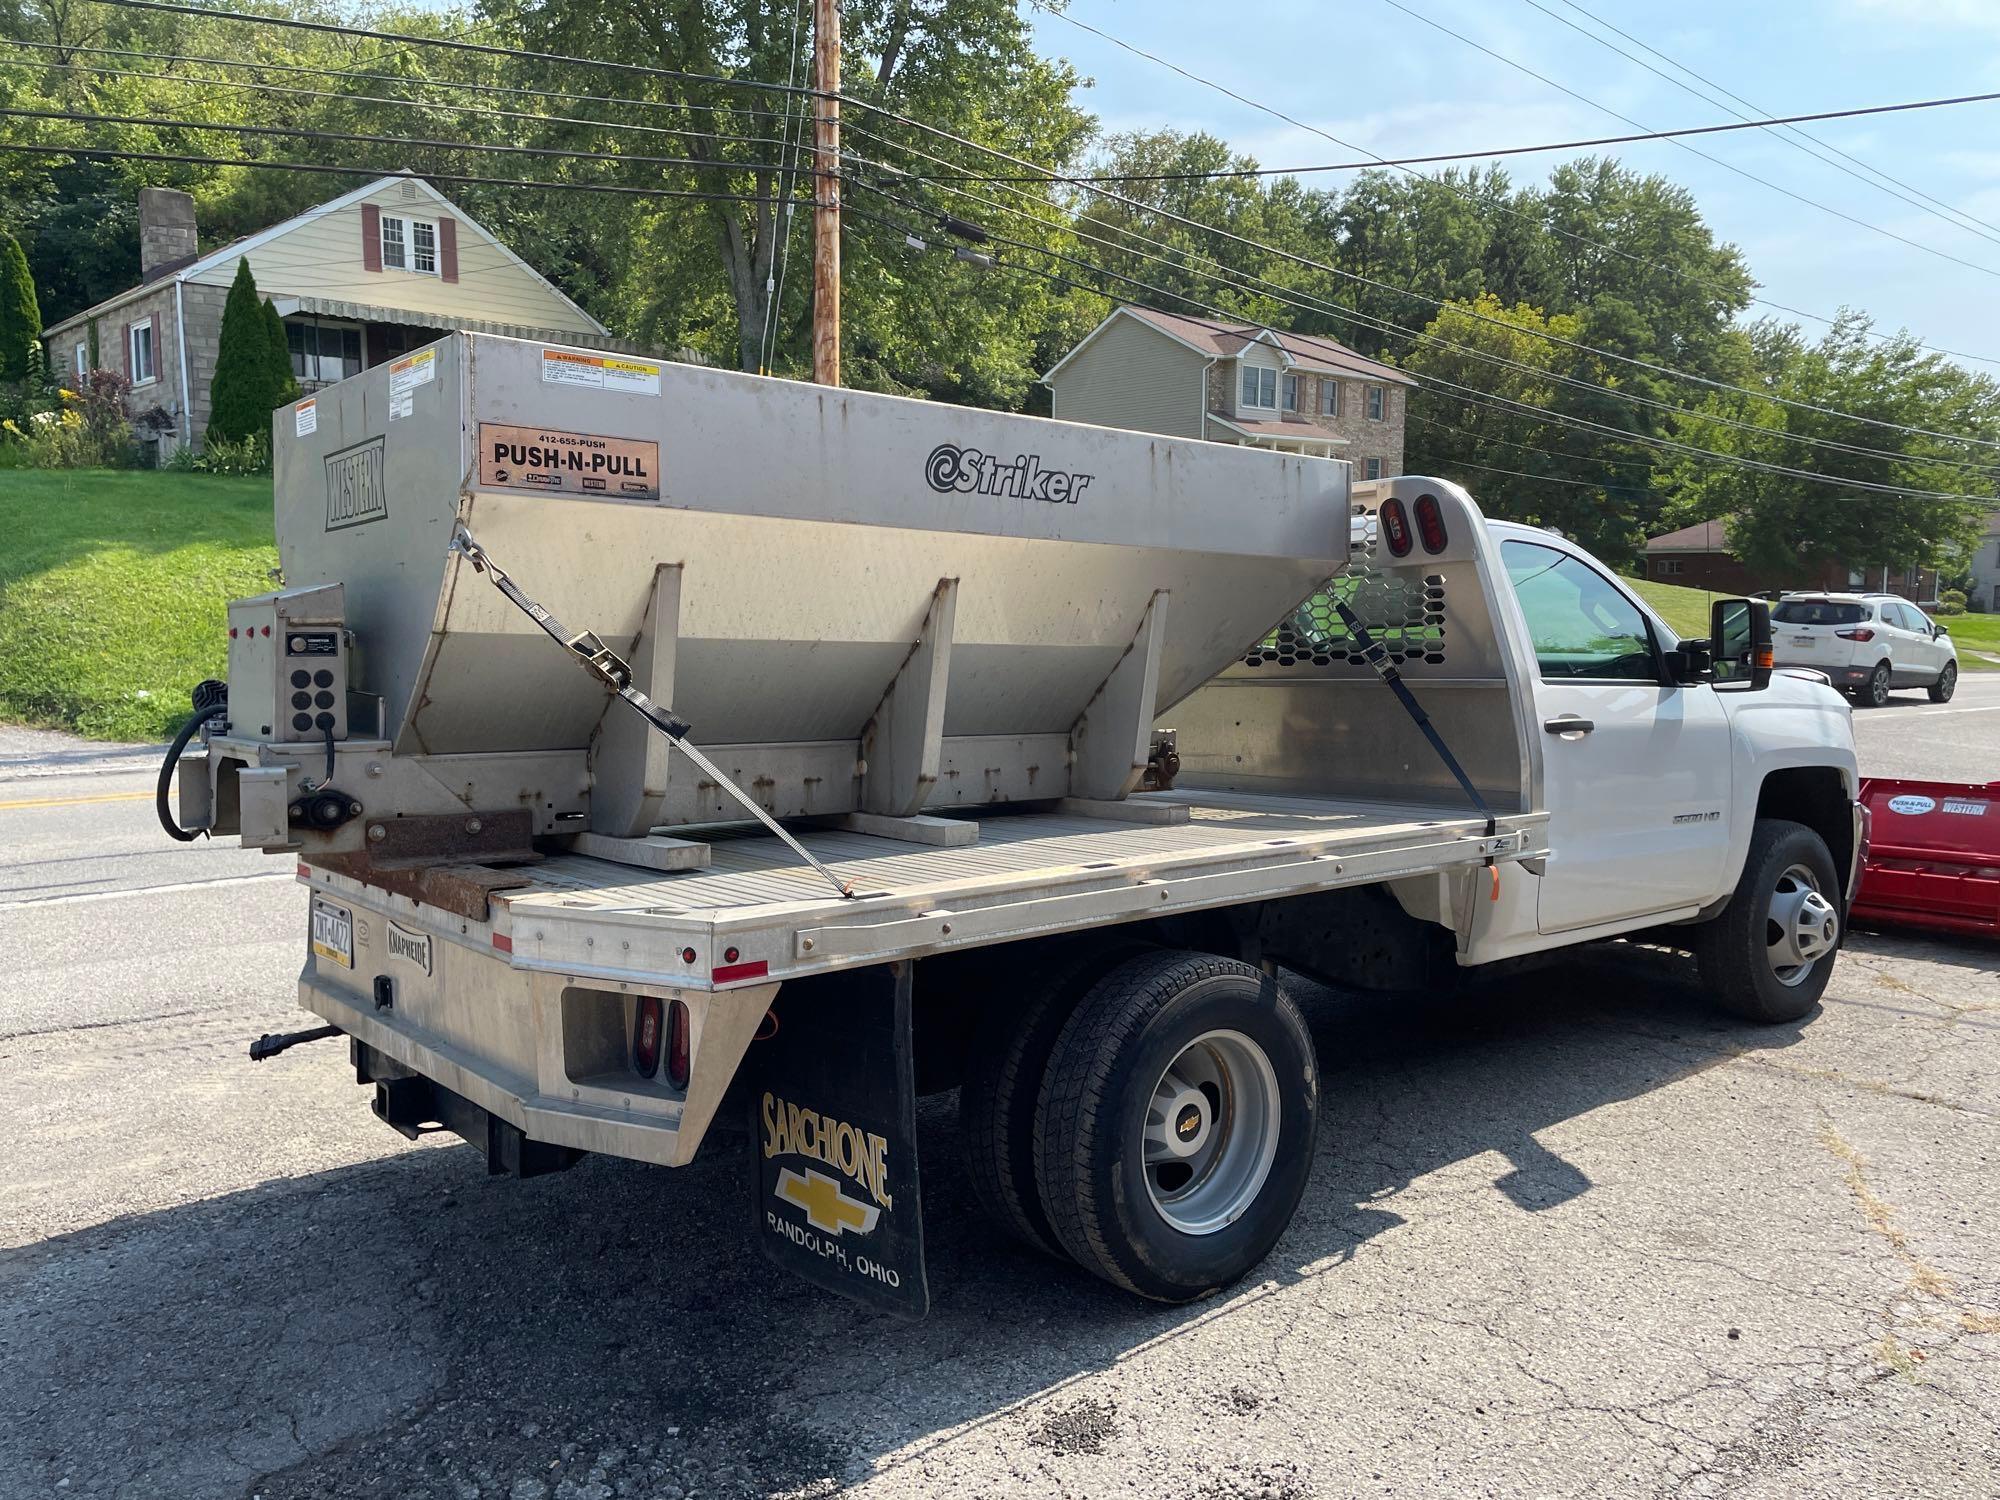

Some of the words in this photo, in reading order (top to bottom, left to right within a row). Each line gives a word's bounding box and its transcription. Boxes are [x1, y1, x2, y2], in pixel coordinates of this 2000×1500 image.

[562, 355, 591, 365] WARNING
[621, 363, 648, 373] CAUTION
[494, 443, 647, 478] PUSH-N-PULL
[538, 434, 606, 449] 412-655-PUSH
[327, 446, 384, 522] WESTERN
[388, 926, 427, 971] KNAPHEIDE
[762, 1091, 893, 1212] SARCHIONE
[767, 1210, 853, 1273] RANDOLPH,
[856, 1255, 900, 1288] OHIO
